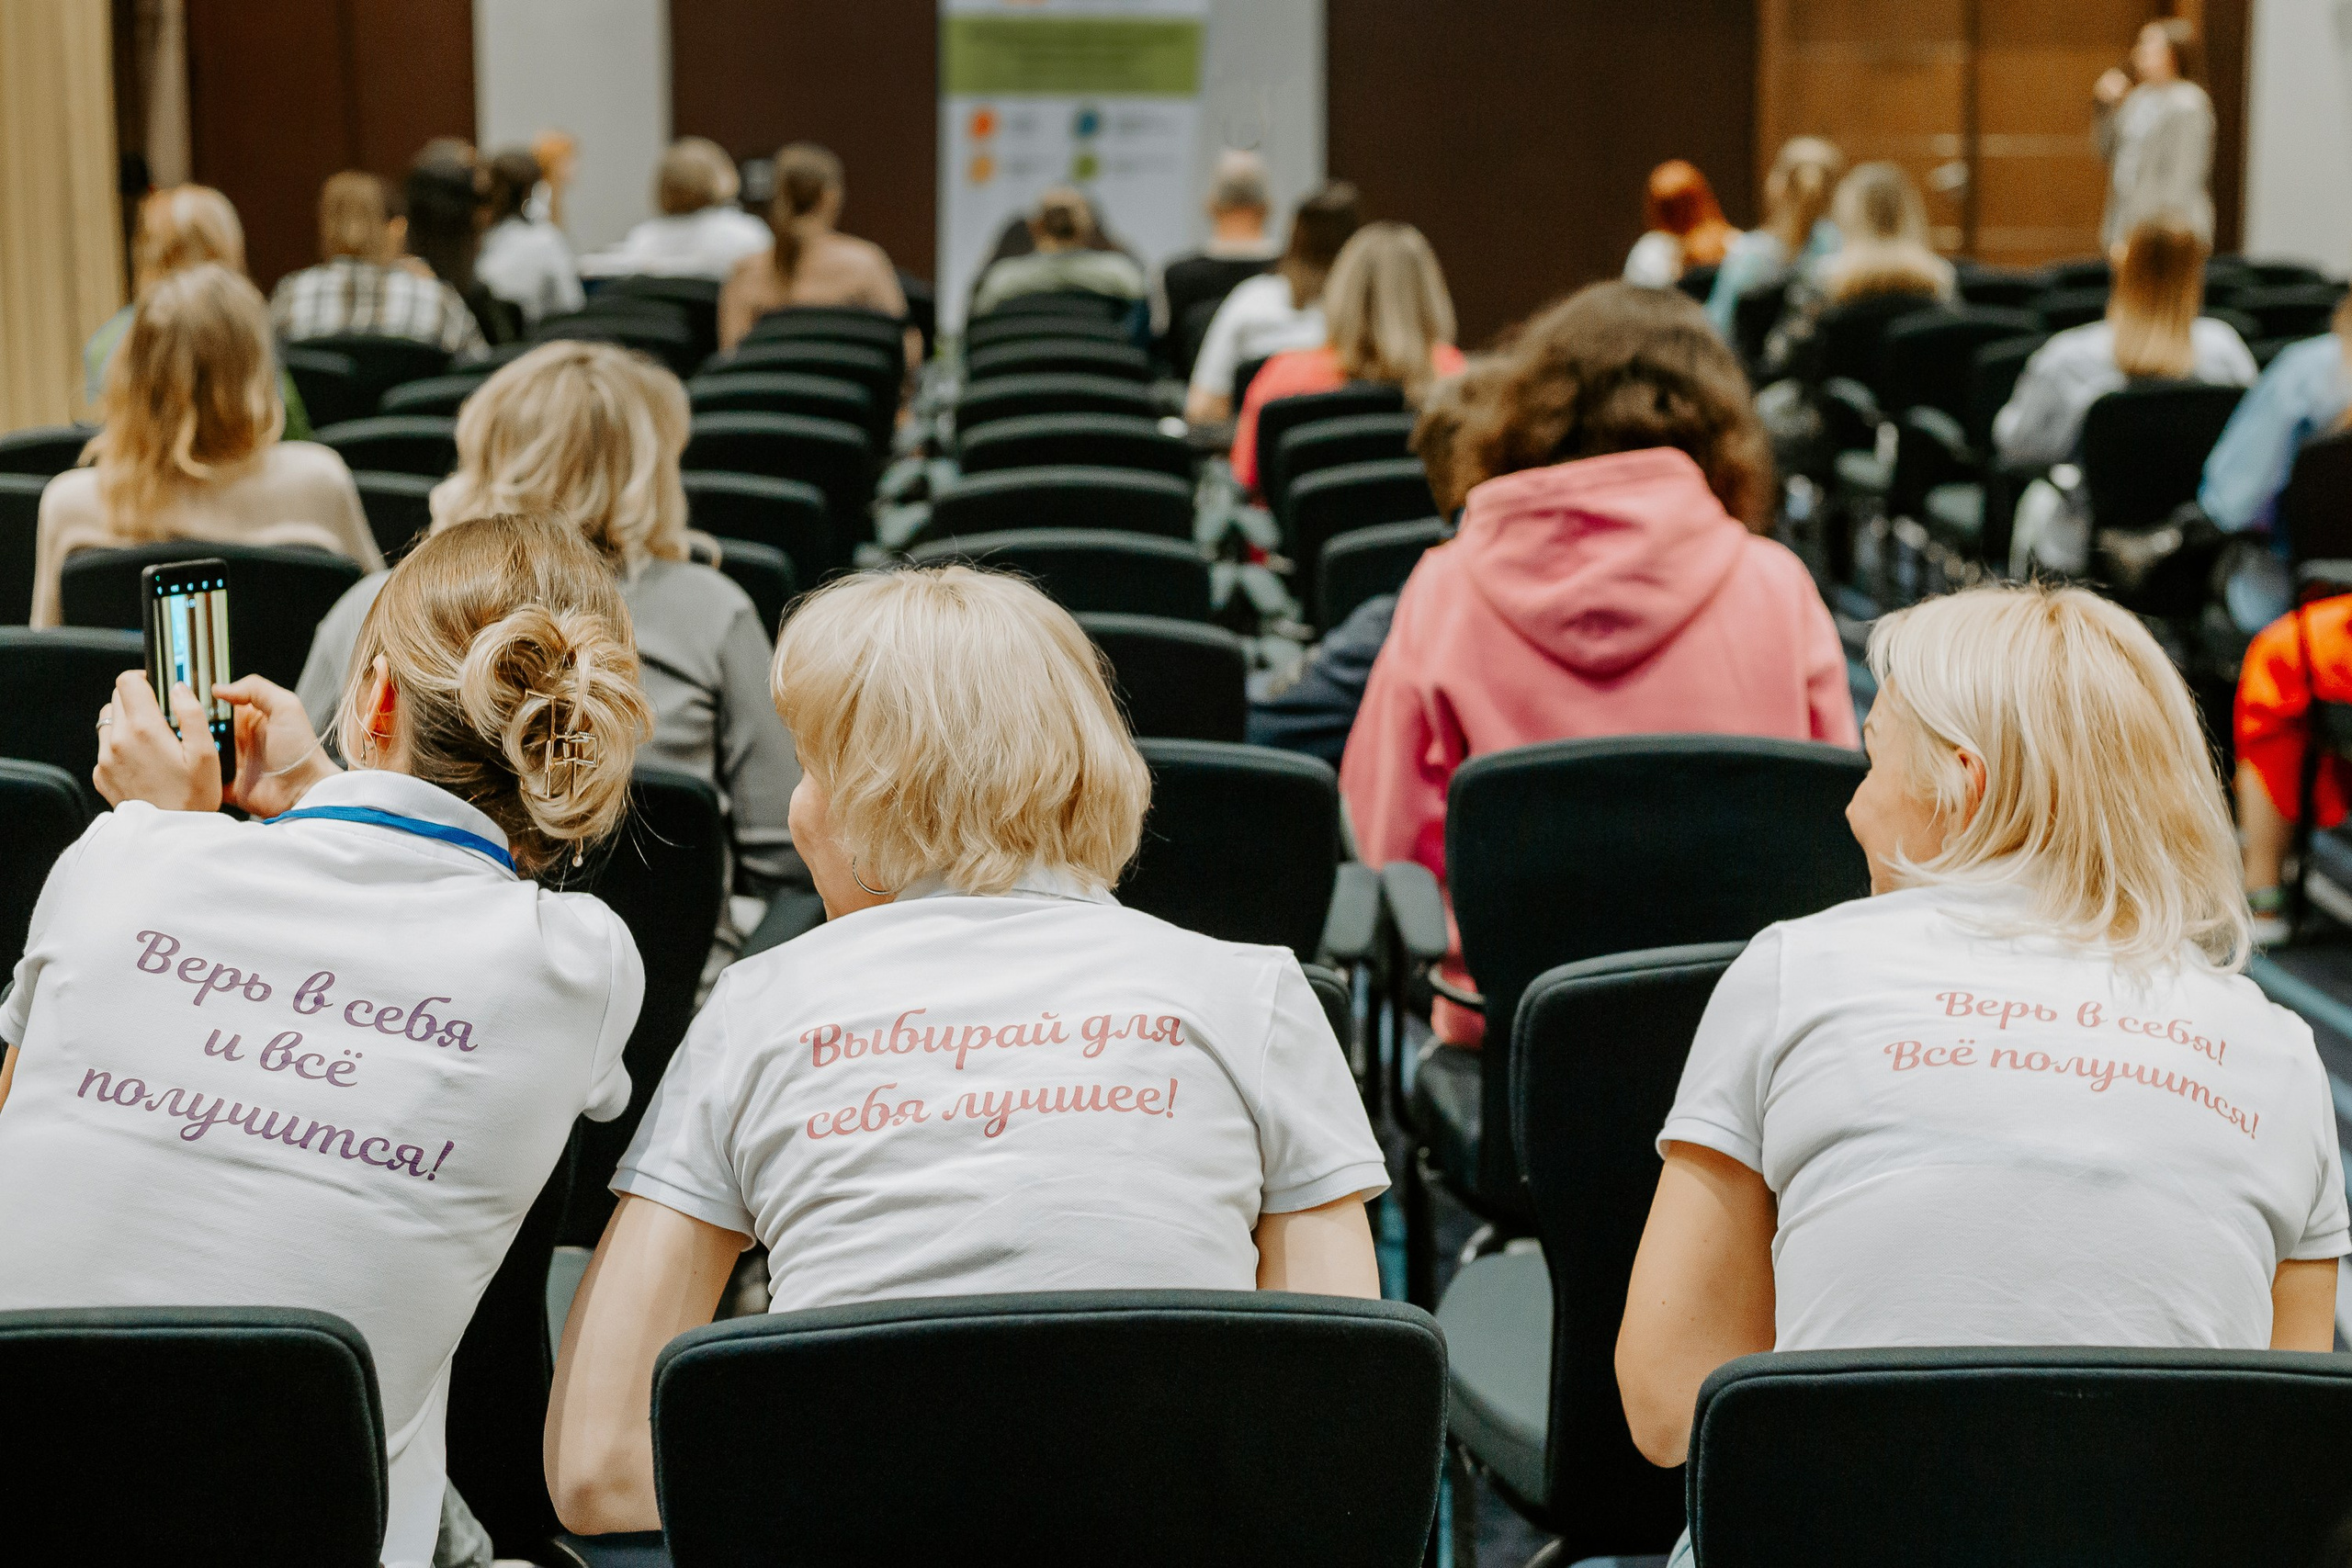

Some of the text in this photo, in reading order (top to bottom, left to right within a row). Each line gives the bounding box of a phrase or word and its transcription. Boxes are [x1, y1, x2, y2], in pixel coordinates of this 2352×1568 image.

[136, 930, 479, 1053] Верь в себя
[1935, 991, 2227, 1066] Верь в себя!
[204, 1028, 364, 1088] и всё
[799, 1008, 1185, 1070] Выбирай для
[76, 1067, 456, 1181] получится!
[806, 1077, 1179, 1140] себя лучшее!
[1883, 1038, 2260, 1140] Всё получится!
